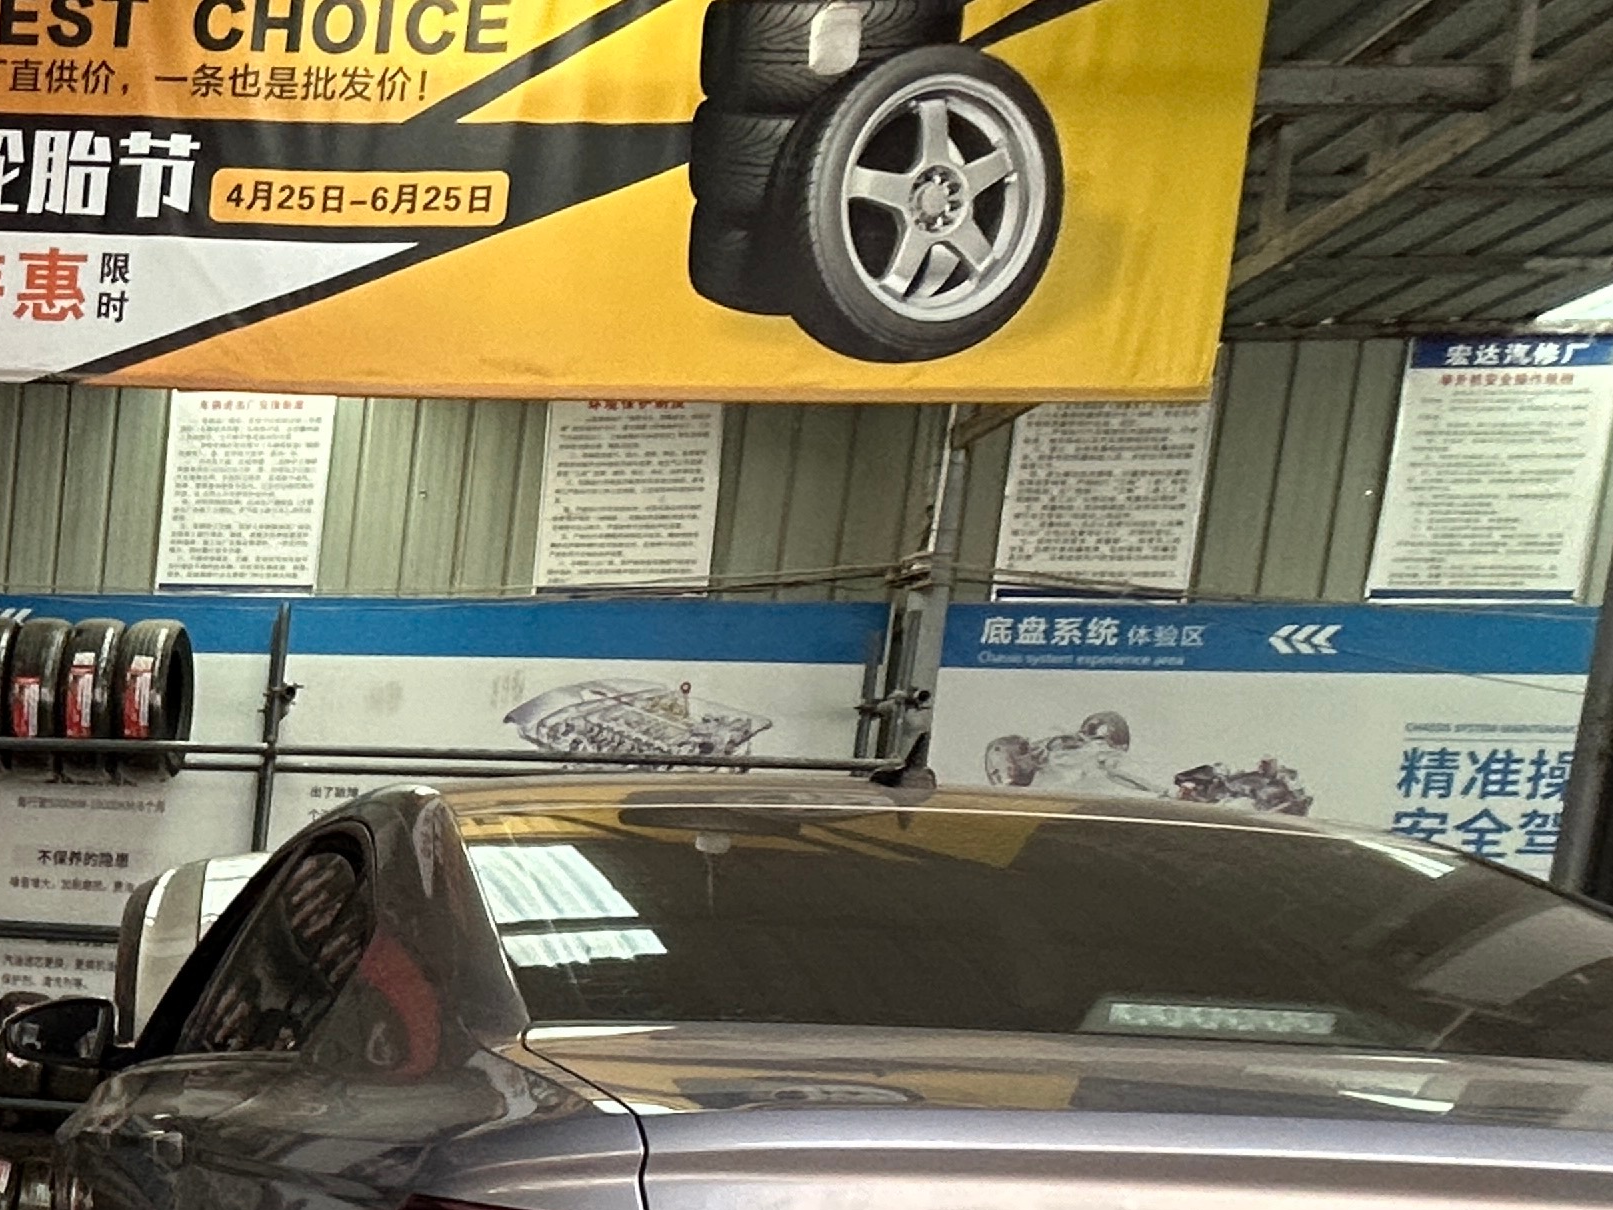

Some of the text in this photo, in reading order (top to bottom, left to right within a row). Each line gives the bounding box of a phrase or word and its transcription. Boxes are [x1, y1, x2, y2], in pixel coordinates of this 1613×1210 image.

[193, 0, 510, 55] CHOICE
[225, 181, 494, 215] 4月25日-6月25日
[96, 252, 132, 323] 限时
[1444, 342, 1591, 367] 宏达汽修厂
[980, 616, 1208, 648] 底盘系统 体验区
[1396, 746, 1575, 800] 精准操
